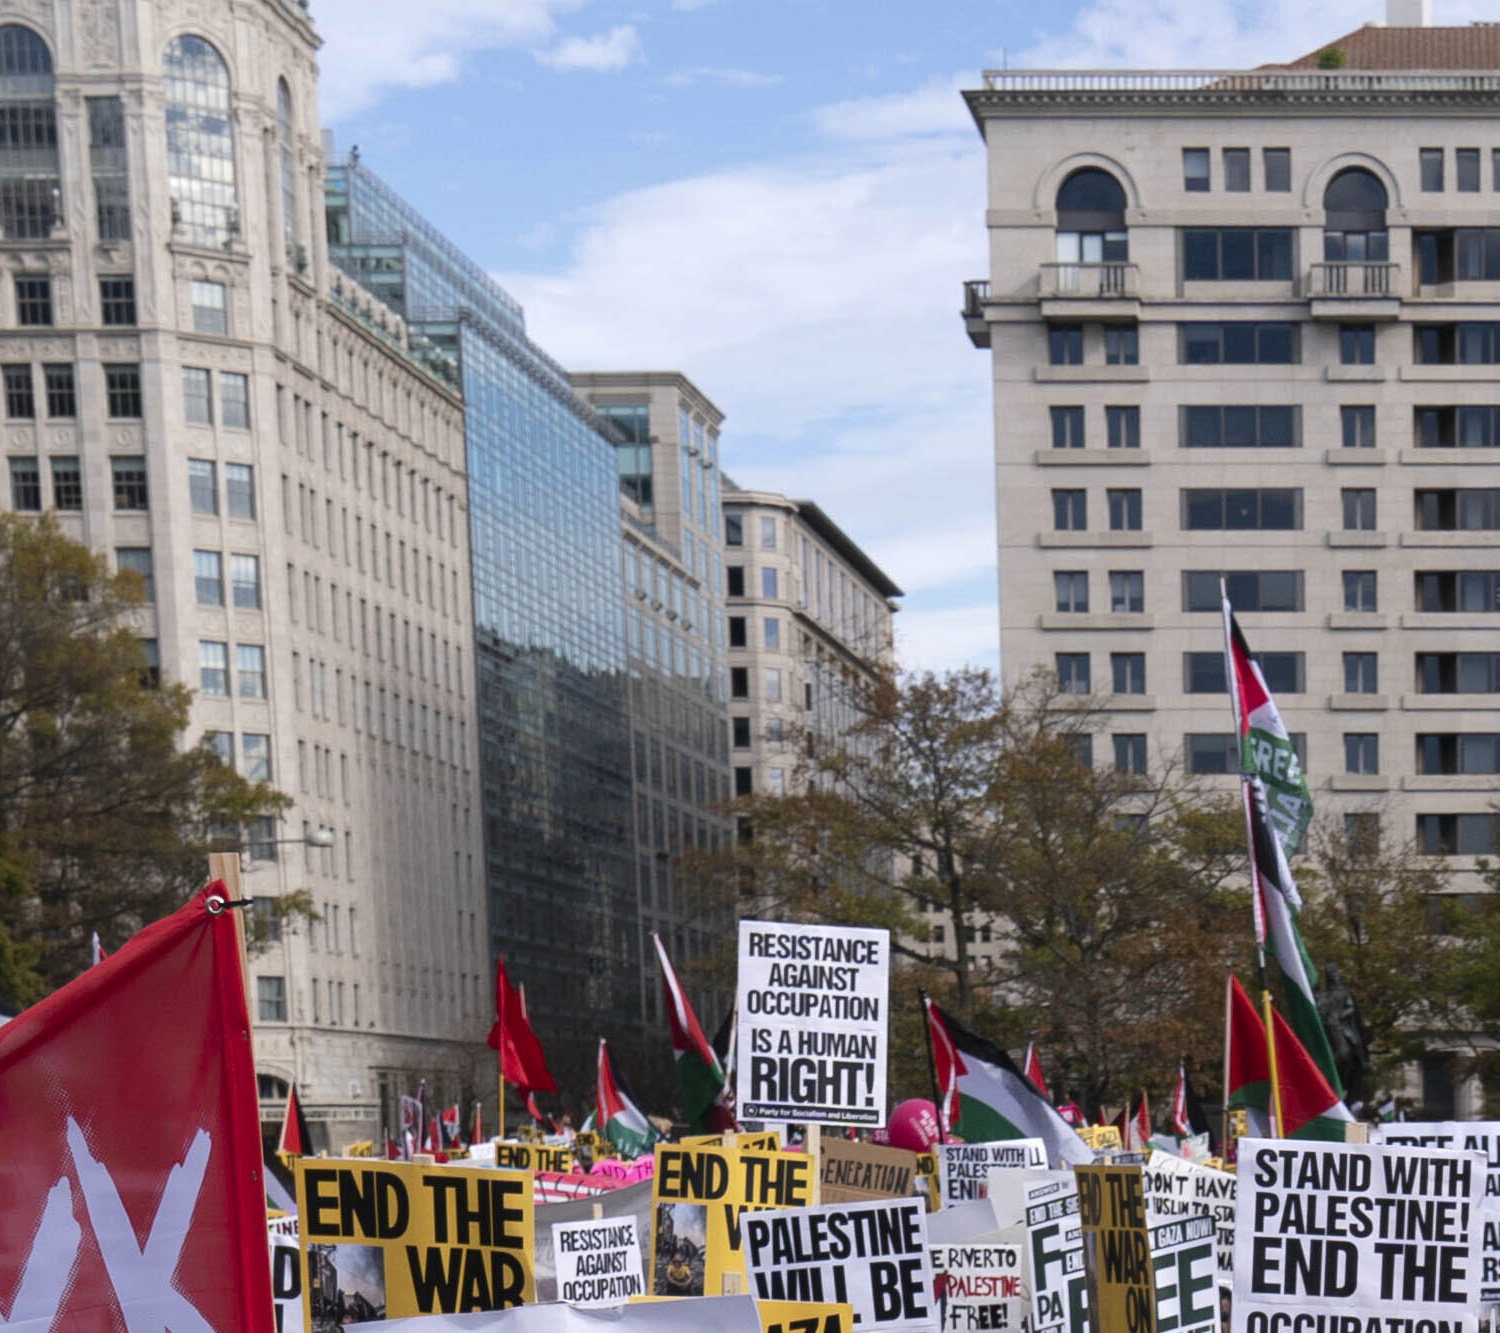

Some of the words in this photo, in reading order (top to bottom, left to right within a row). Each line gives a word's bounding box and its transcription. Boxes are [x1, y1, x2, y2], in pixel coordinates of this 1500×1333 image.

[749, 932, 879, 965] RESISTANCE
[768, 963, 860, 992] AGAINST
[747, 990, 878, 1021] OCCUPATION
[752, 1028, 772, 1053] IS
[778, 1030, 792, 1054] A
[799, 1031, 876, 1059] HUMAN
[751, 1056, 875, 1107] RIGHT!
[1255, 1149, 1372, 1192] STAND
[1383, 1154, 1470, 1197] WITH
[1254, 1193, 1469, 1242] PALESTINE!
[1252, 1237, 1357, 1299] END
[1375, 1243, 1468, 1303] THE
